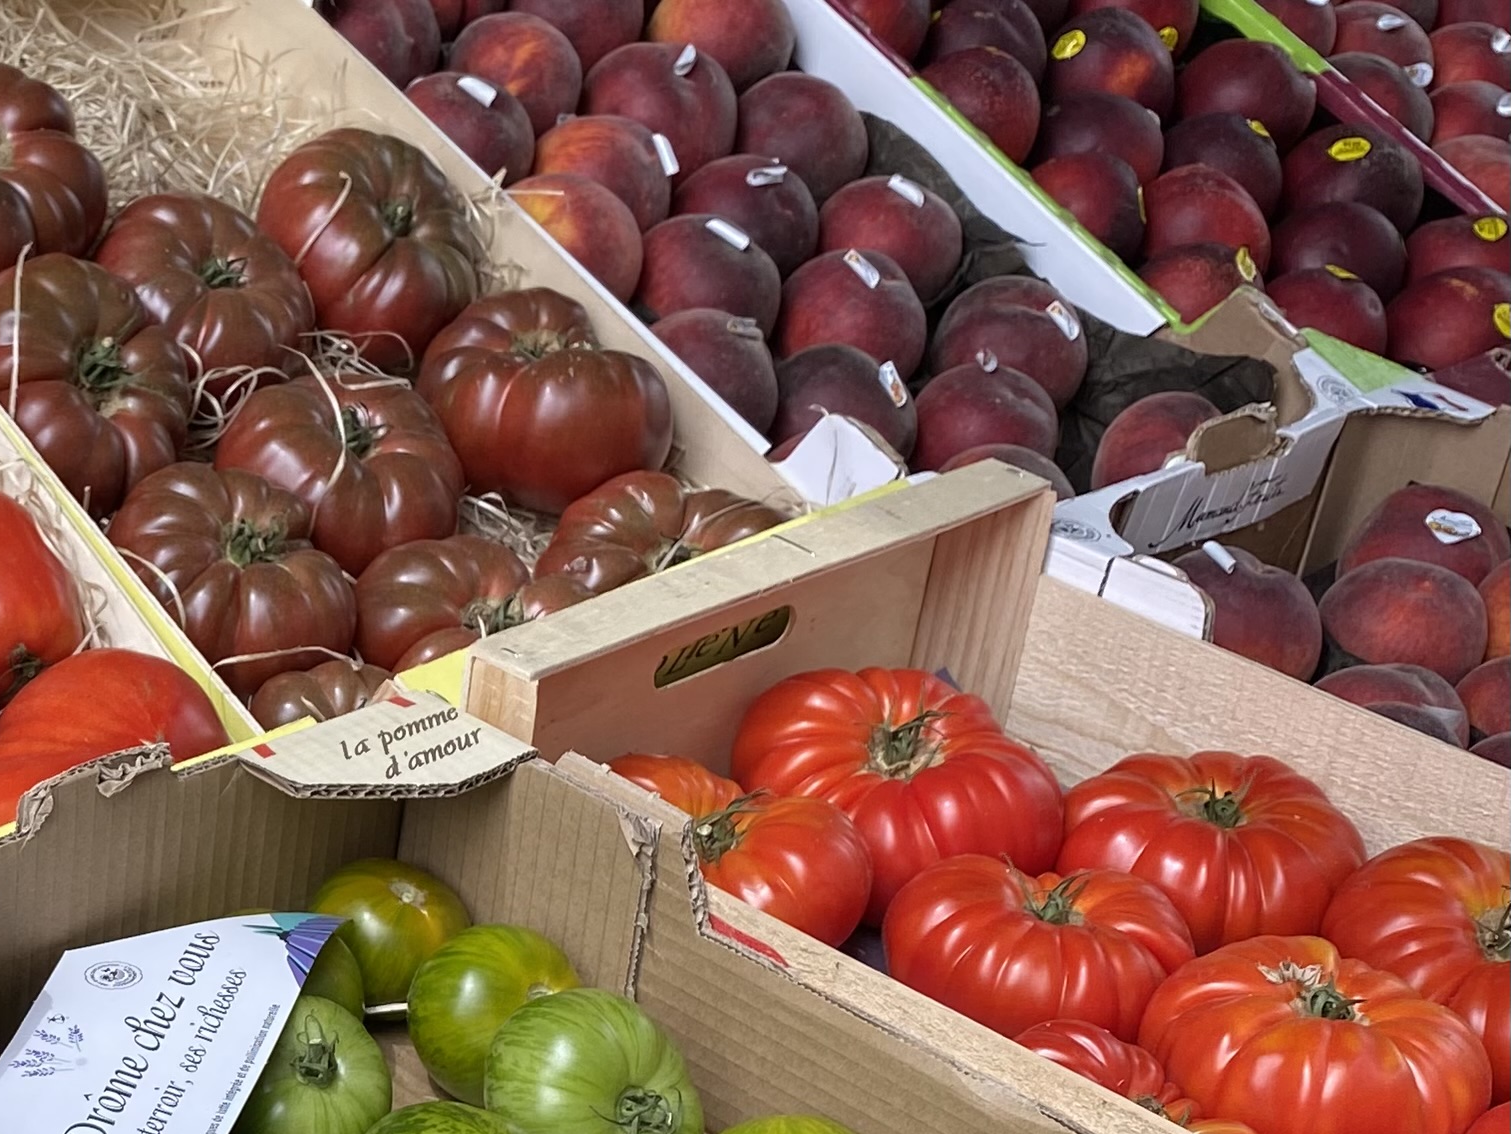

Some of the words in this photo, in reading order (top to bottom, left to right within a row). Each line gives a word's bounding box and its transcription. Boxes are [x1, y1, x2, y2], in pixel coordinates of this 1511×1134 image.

[340, 738, 371, 760] la
[378, 707, 458, 755] pomme
[386, 728, 481, 779] d'amour
[124, 992, 185, 1051] chez
[168, 930, 220, 986] vous
[190, 967, 247, 1042] richesses
[180, 1044, 207, 1073] ses
